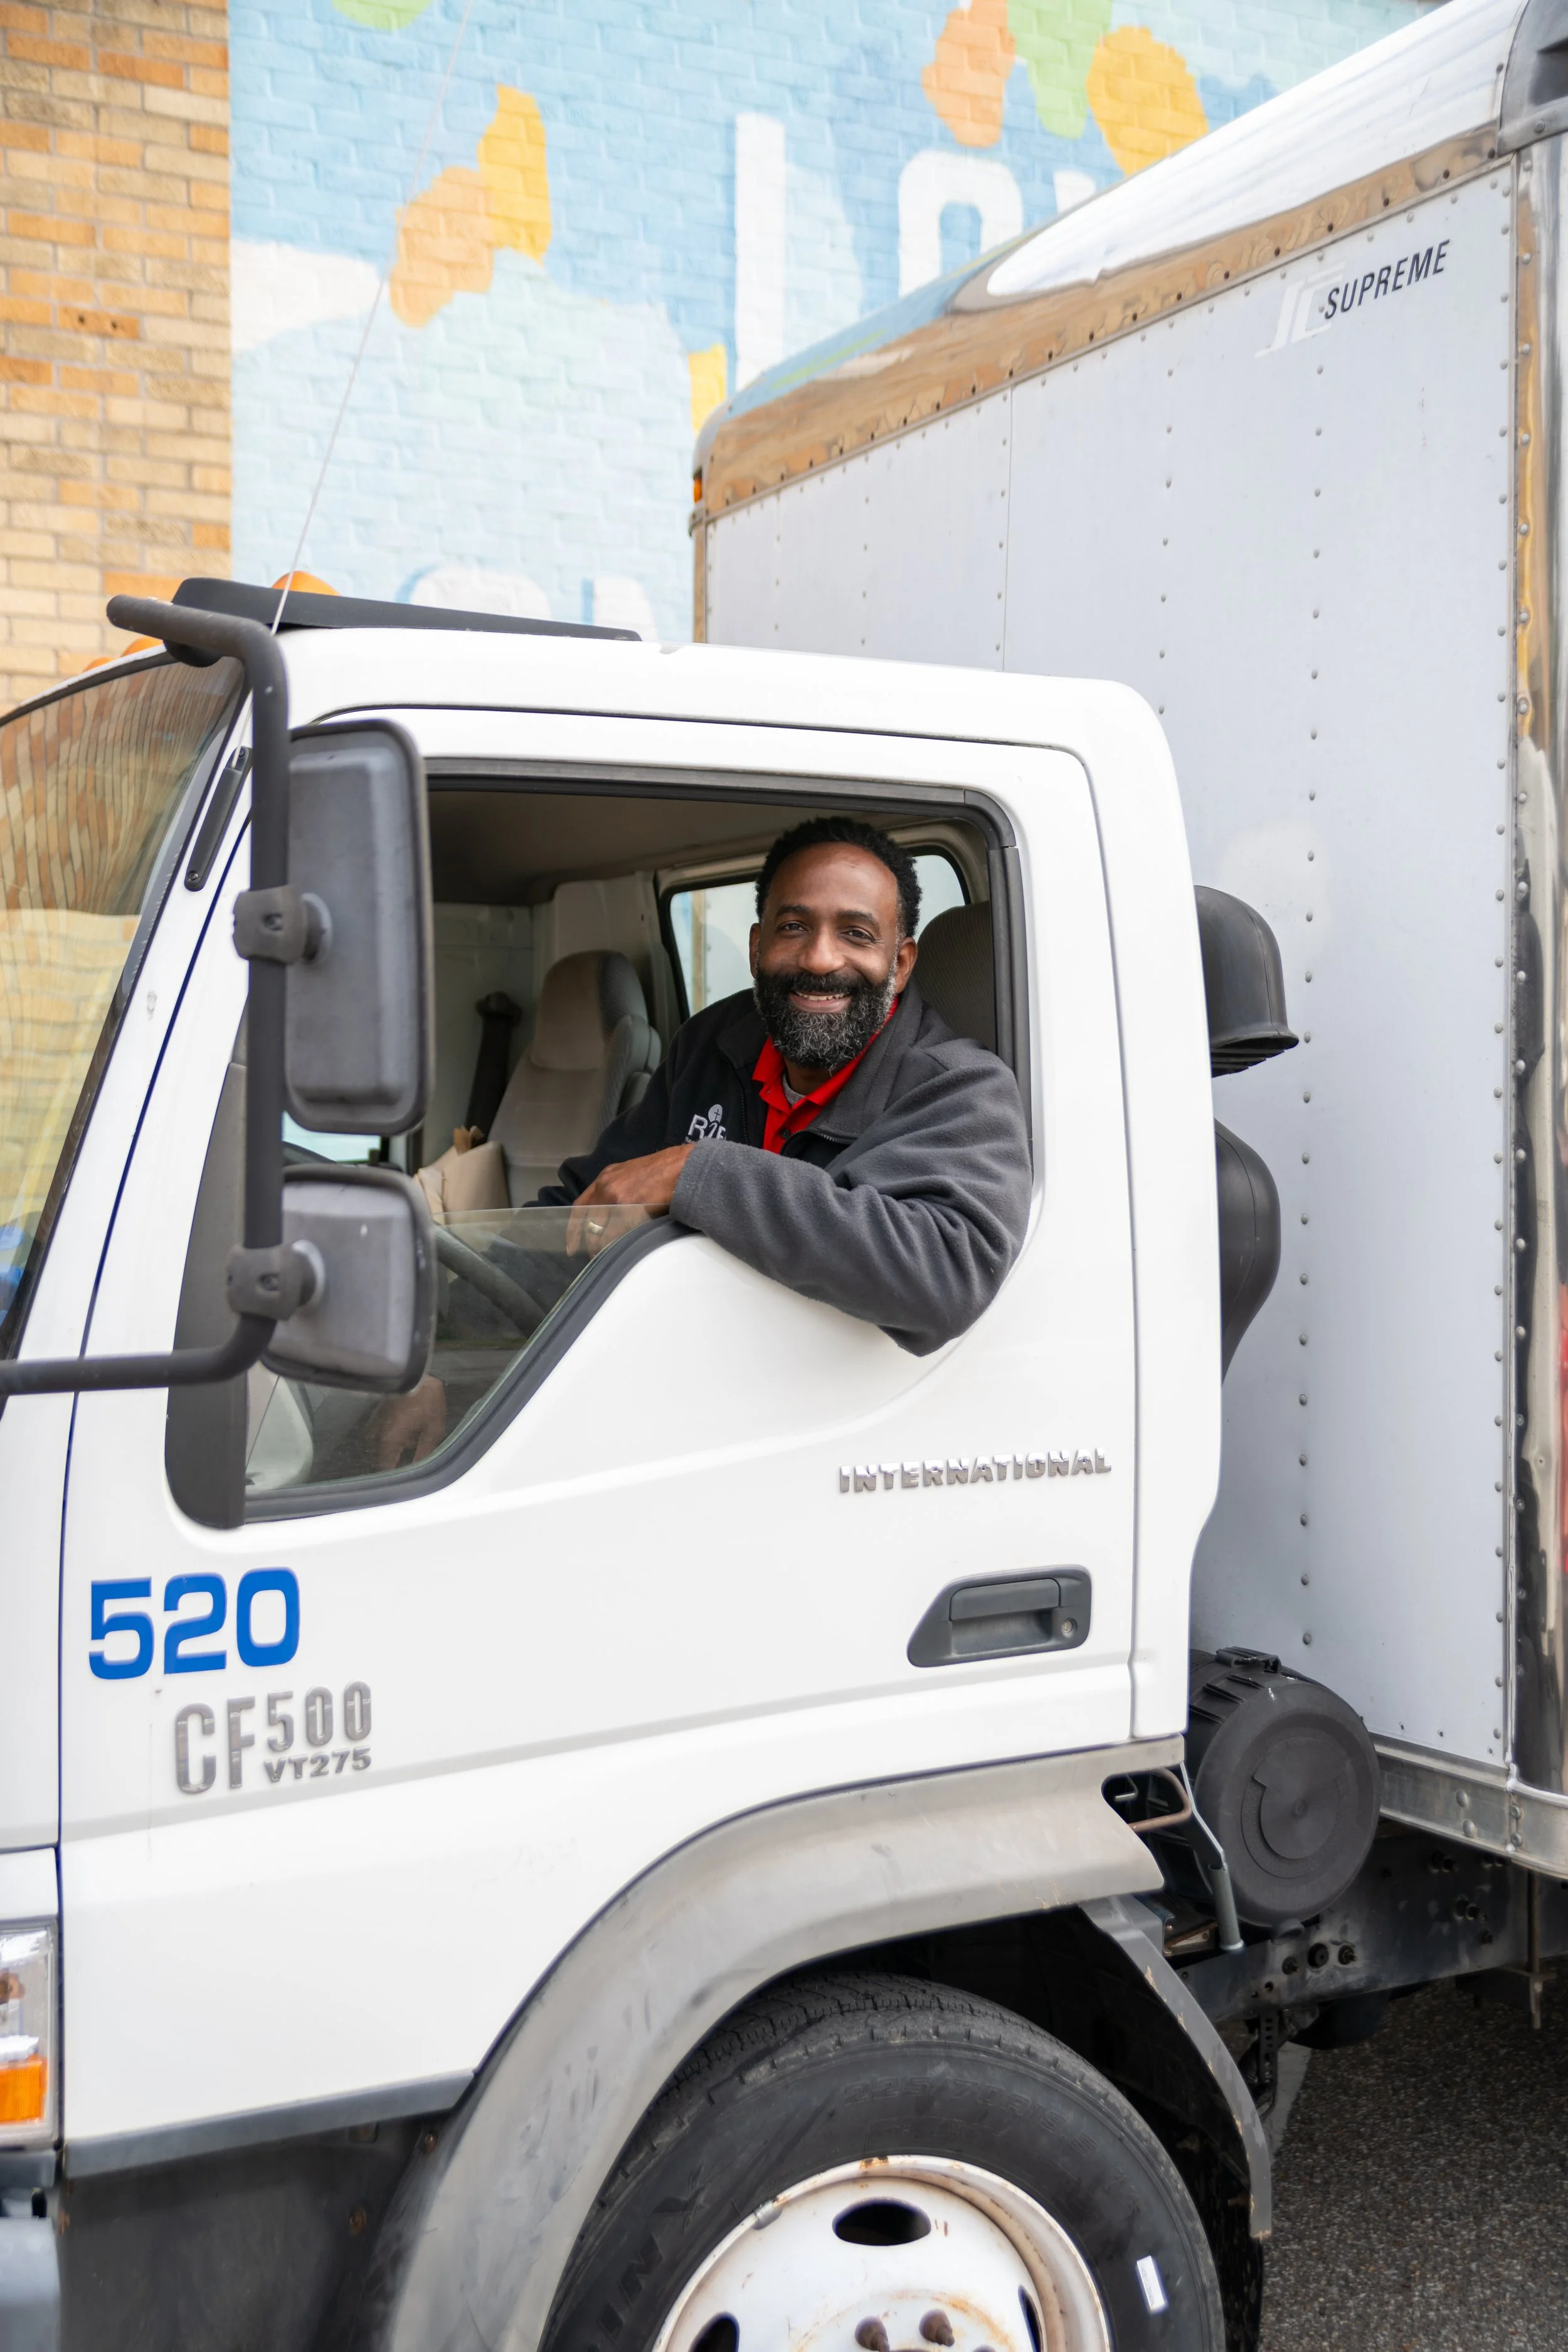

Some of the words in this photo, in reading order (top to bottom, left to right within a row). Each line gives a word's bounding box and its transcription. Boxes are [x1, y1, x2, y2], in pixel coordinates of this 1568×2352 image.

[1324, 239, 1450, 320] SUPREME
[839, 1447, 1112, 1493] INTERNATIONAL
[88, 1566, 300, 1680] 520
[174, 1680, 372, 1795] CF500
[263, 1746, 371, 1783] VT275
